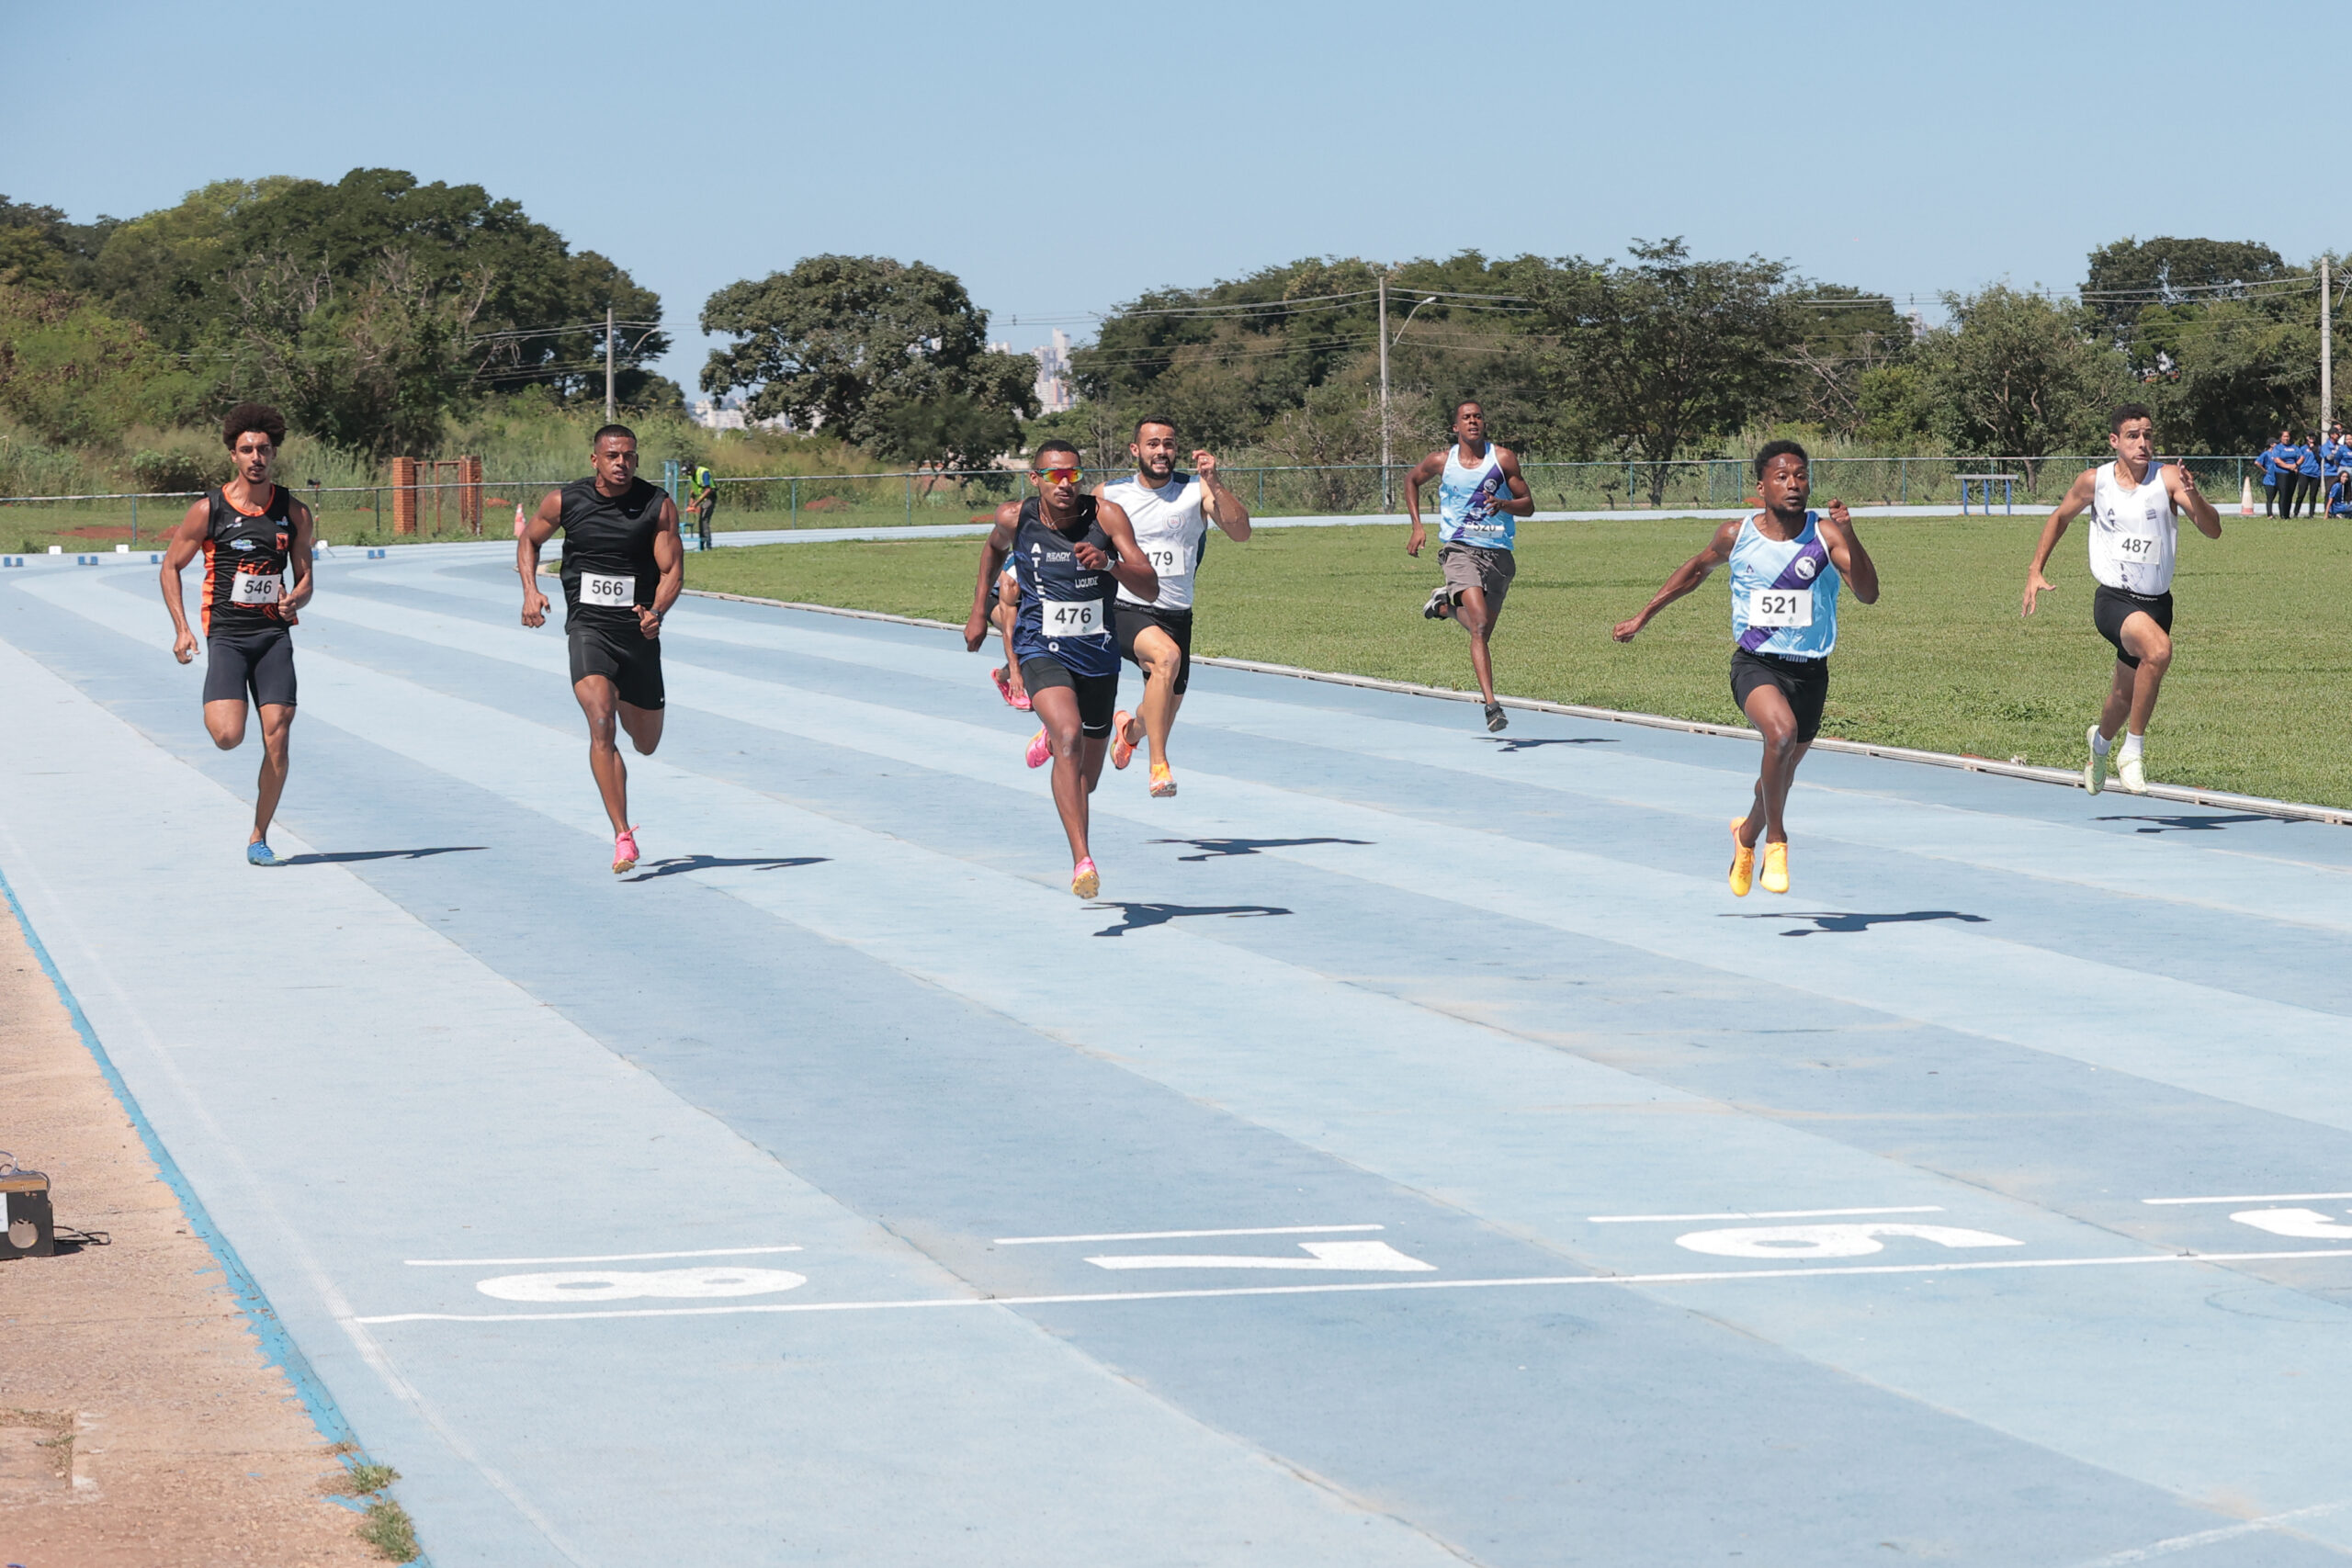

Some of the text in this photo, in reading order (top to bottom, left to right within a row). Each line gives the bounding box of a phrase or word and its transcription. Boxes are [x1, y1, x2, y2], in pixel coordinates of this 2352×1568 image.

[2121, 538, 2153, 554] 487
[243, 580, 272, 594] 546
[592, 580, 624, 596] 566
[1761, 596, 1796, 614] 521
[1055, 607, 1091, 625] 476
[475, 1267, 807, 1303] 8
